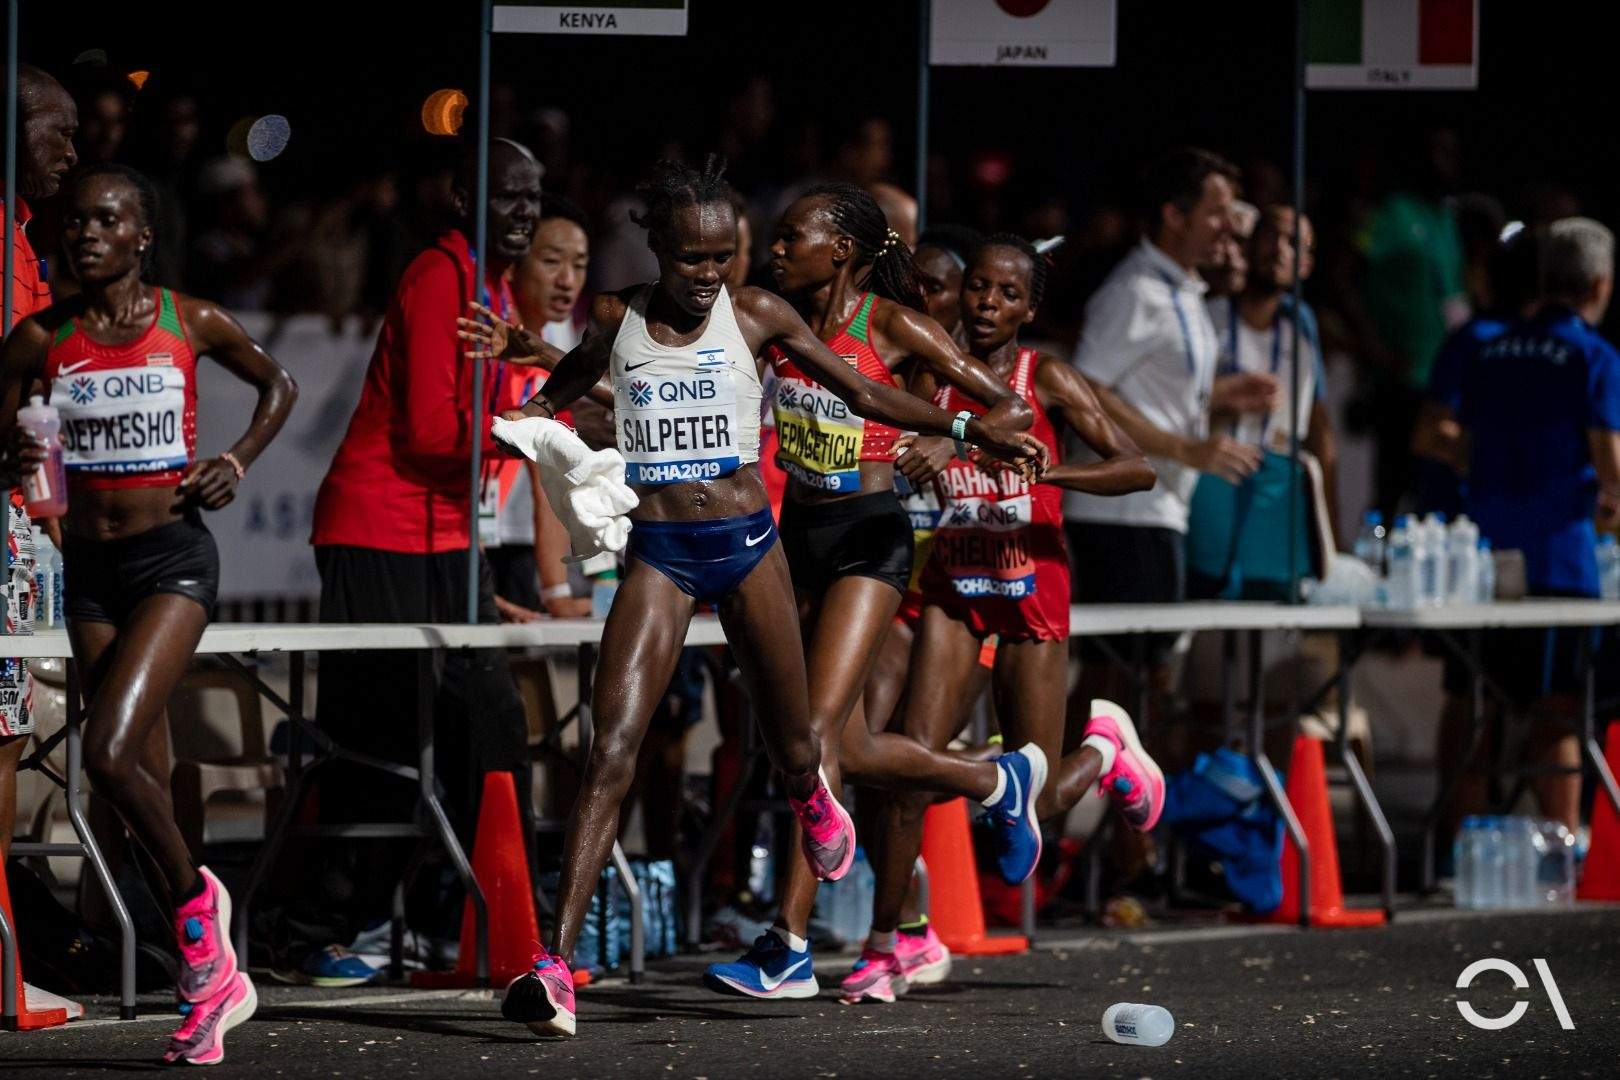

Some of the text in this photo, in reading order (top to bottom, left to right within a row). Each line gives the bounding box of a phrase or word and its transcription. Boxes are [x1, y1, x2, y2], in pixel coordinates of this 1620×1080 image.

[560, 13, 617, 28] KENYA
[996, 45, 1047, 61] JAPAN
[104, 374, 164, 398] QNB
[659, 380, 716, 402] QNB
[801, 393, 847, 419] QNB
[64, 410, 175, 452] JEPKESHO
[623, 414, 730, 452] SALPETER
[779, 421, 857, 466] EPNGETICH
[639, 462, 721, 481] DOHA2019
[977, 504, 1017, 525] QNB
